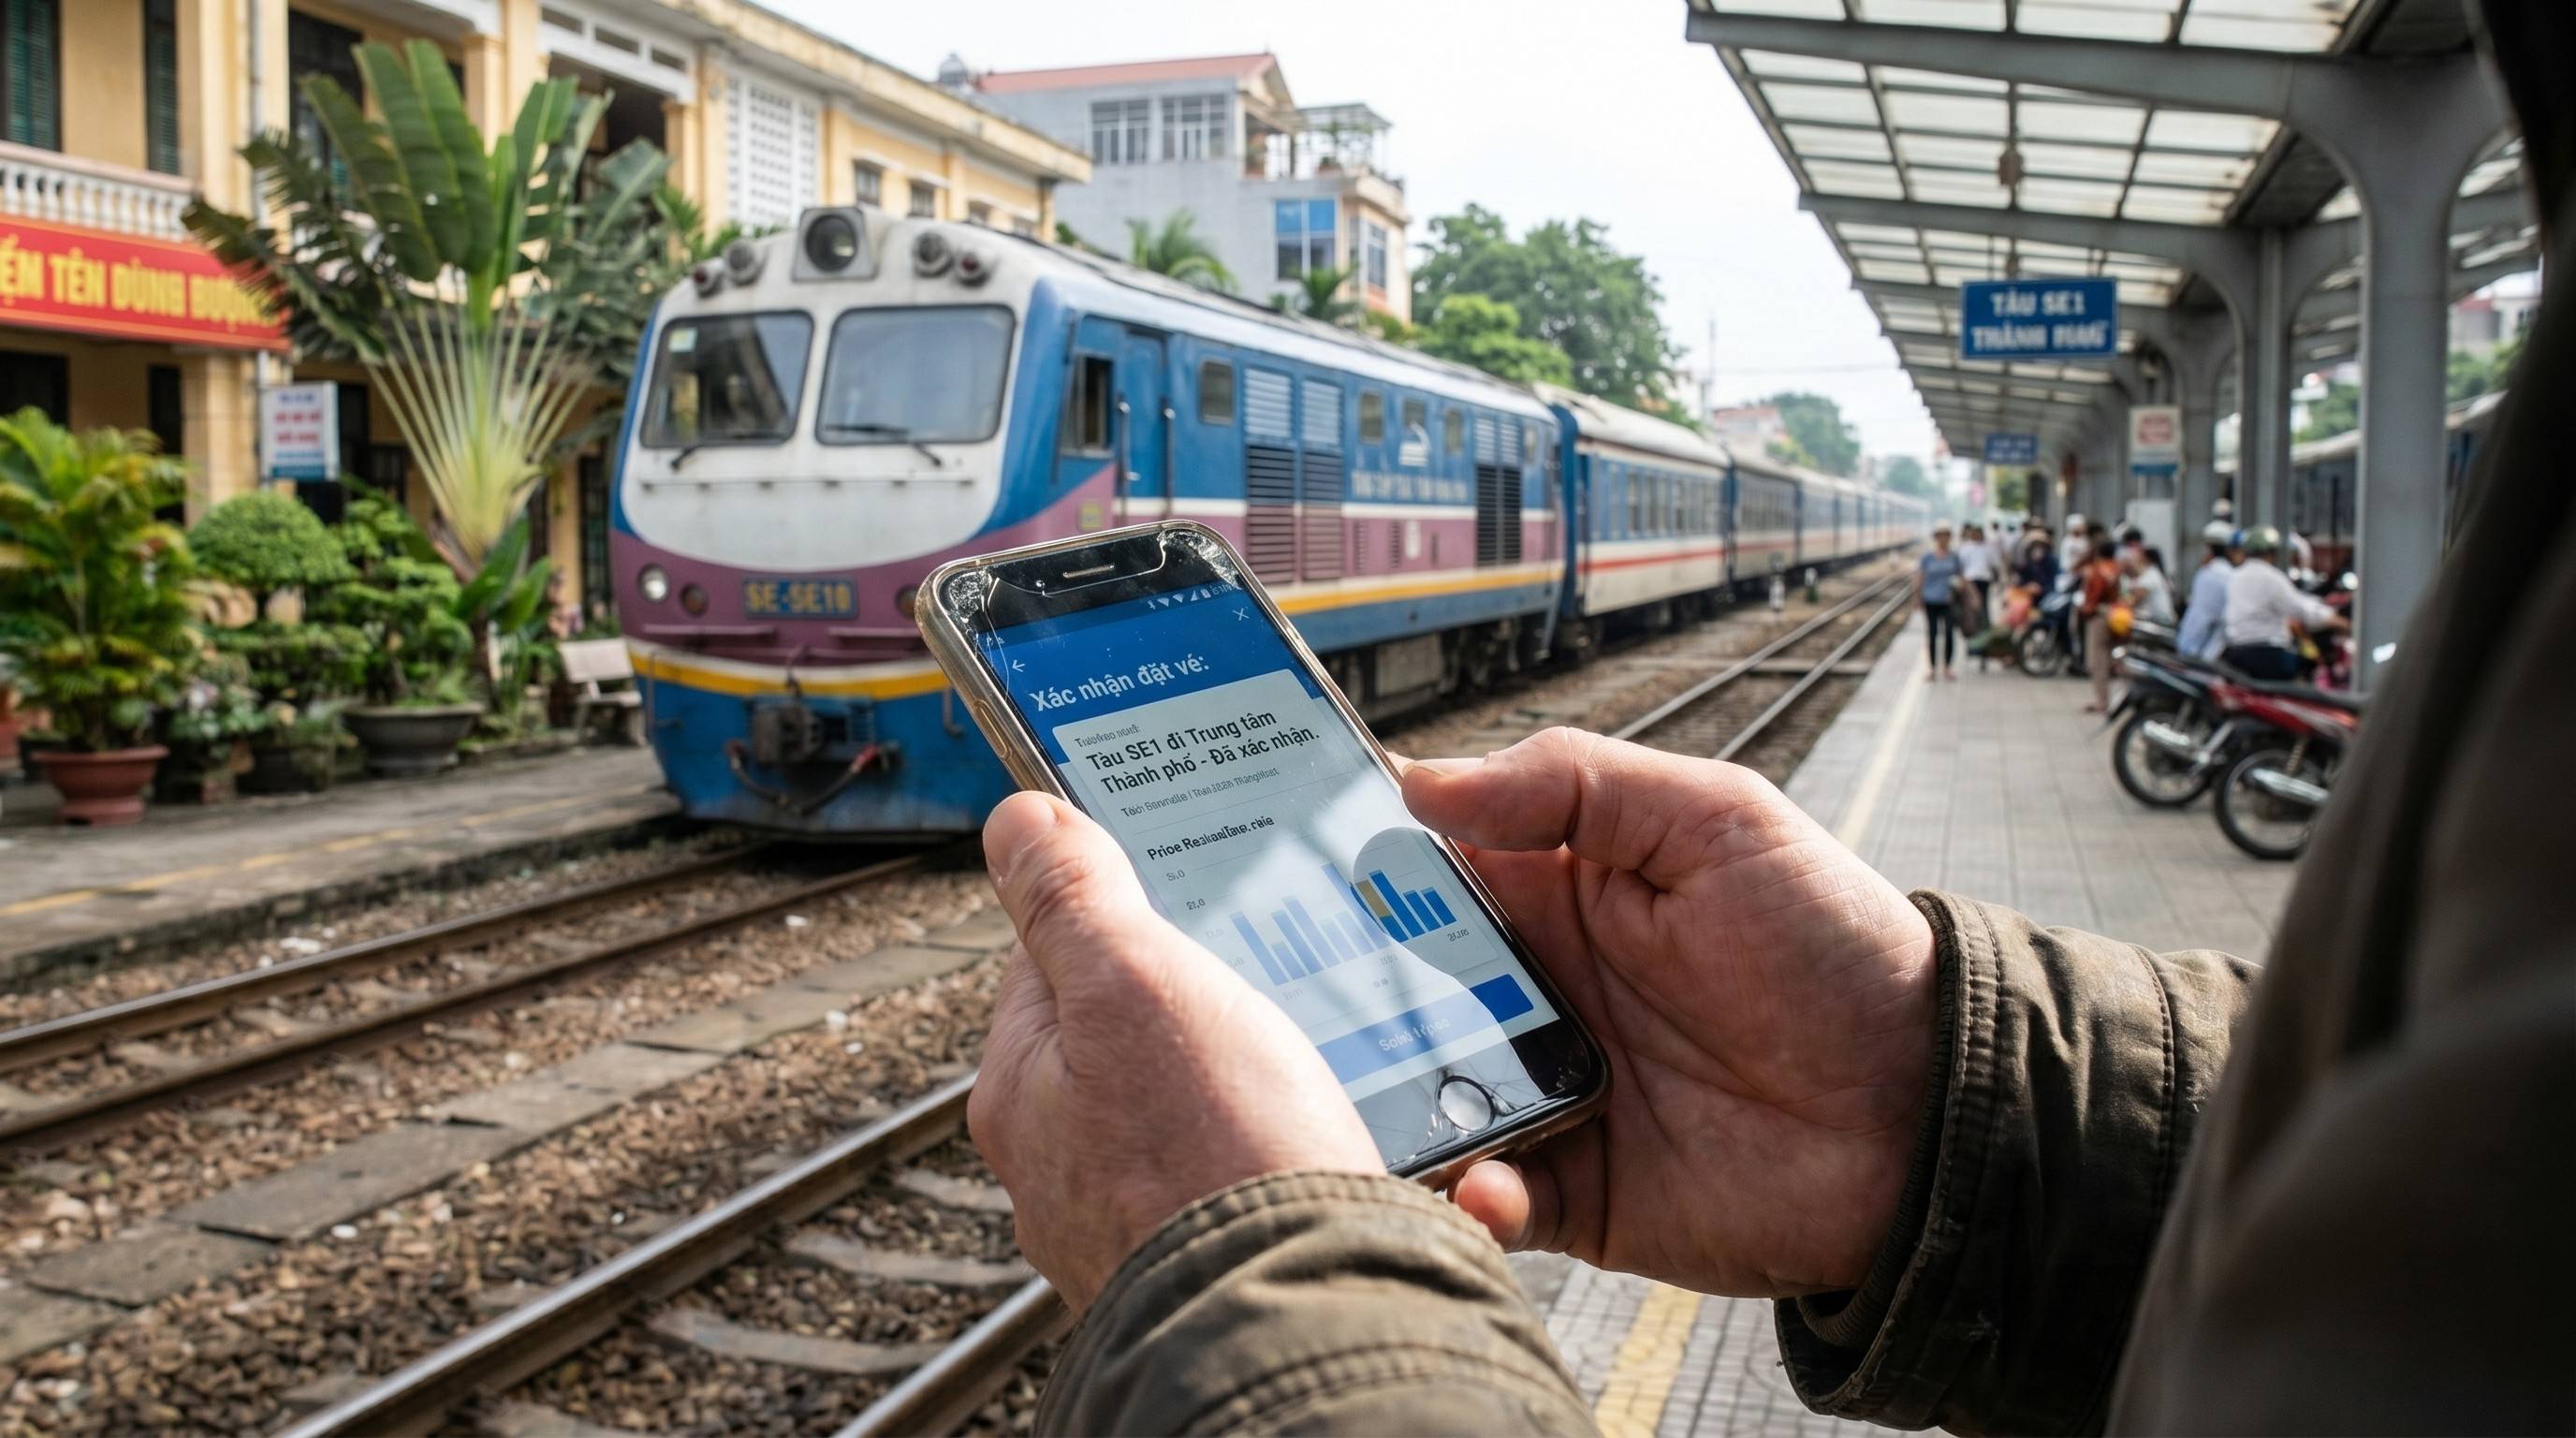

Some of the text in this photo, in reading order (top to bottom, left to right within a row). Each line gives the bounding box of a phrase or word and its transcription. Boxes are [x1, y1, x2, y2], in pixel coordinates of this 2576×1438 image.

[1030, 653, 1210, 712] Xác nhận đặt vé:
[1086, 751, 1126, 770] Tàu
[1125, 738, 1164, 760] SE1
[1166, 731, 1187, 751] đi
[1185, 722, 1242, 745] Trung
[1240, 710, 1278, 733] tâm
[1101, 765, 1162, 794] Thành
[1162, 753, 1197, 782] phố
[1208, 744, 1238, 766] Đã
[1238, 738, 1270, 758] xác
[1270, 726, 1321, 751] nhận.
